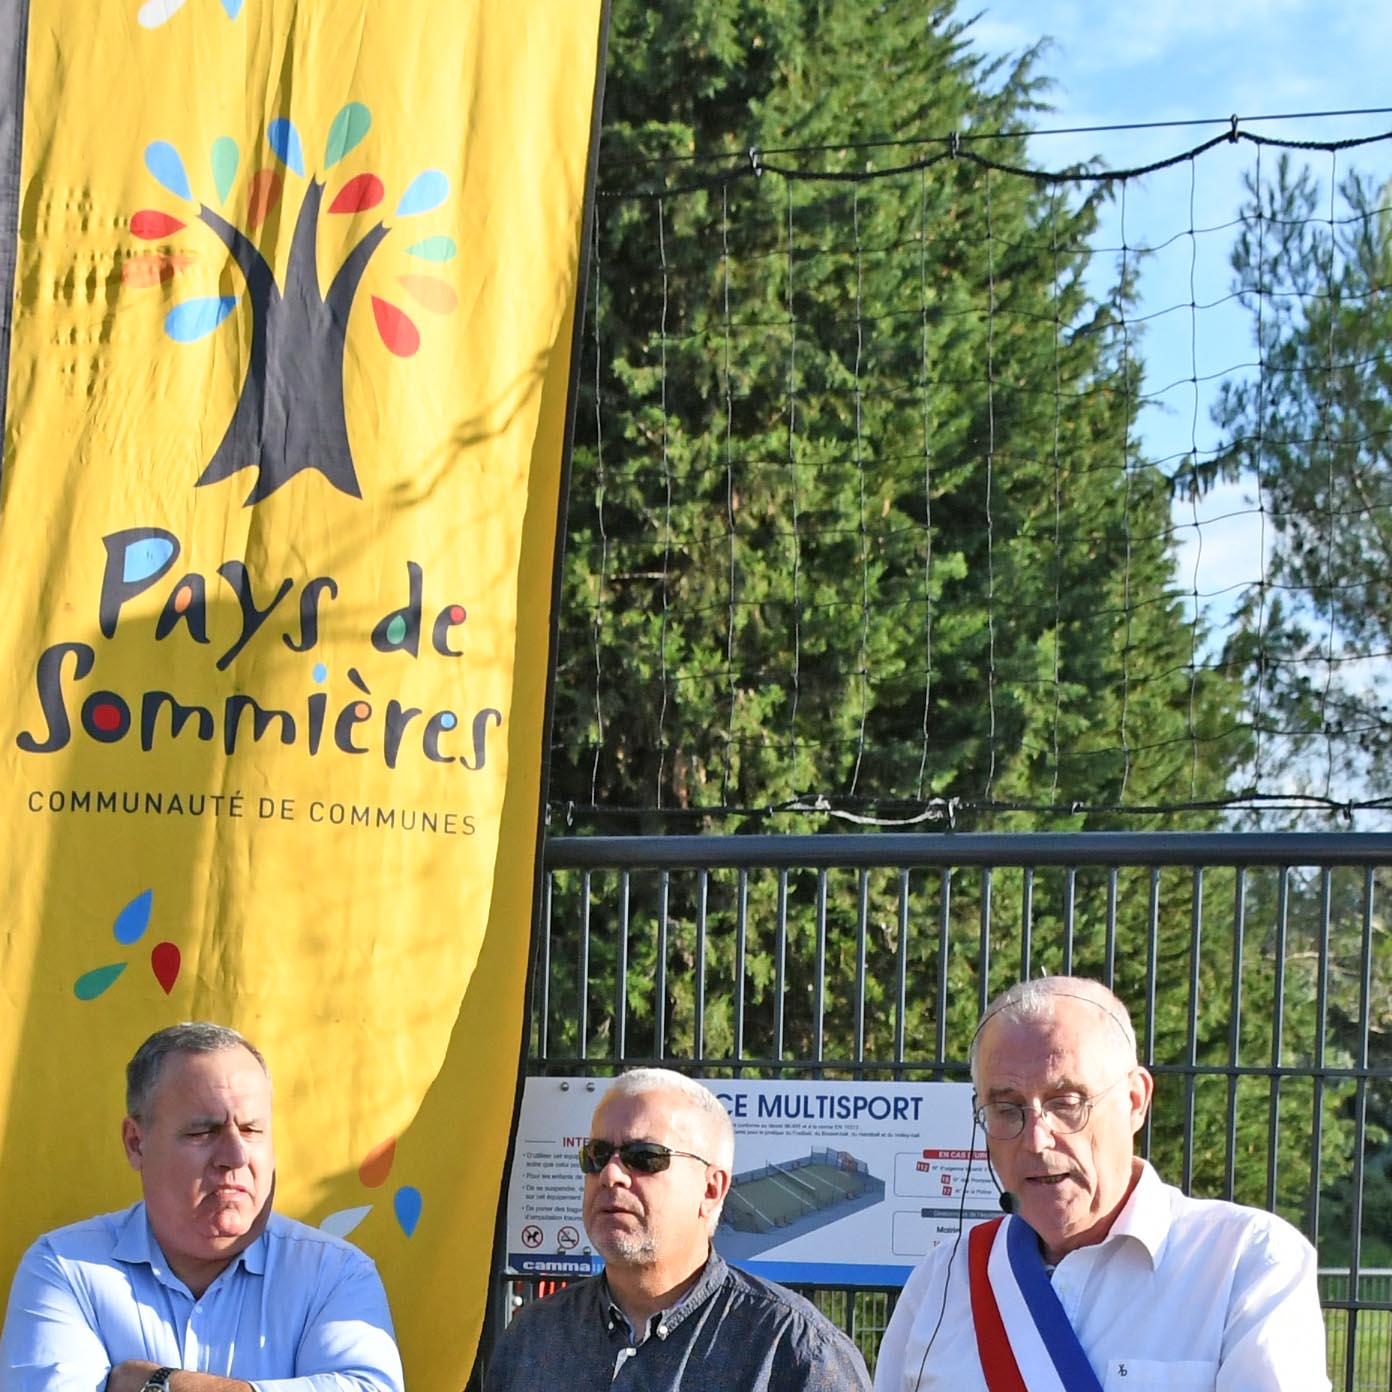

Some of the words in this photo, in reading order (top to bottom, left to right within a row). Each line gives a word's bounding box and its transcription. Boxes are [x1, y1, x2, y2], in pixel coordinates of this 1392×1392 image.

[99, 527, 337, 671] Pays
[372, 561, 466, 659] de
[16, 642, 501, 771] Sommières
[28, 790, 243, 817] COMMUNAUTÉ
[258, 799, 294, 820] DE
[310, 801, 476, 835] COMMUNES
[758, 1094, 923, 1120] MULTISPORT
[522, 1260, 591, 1272] camma
